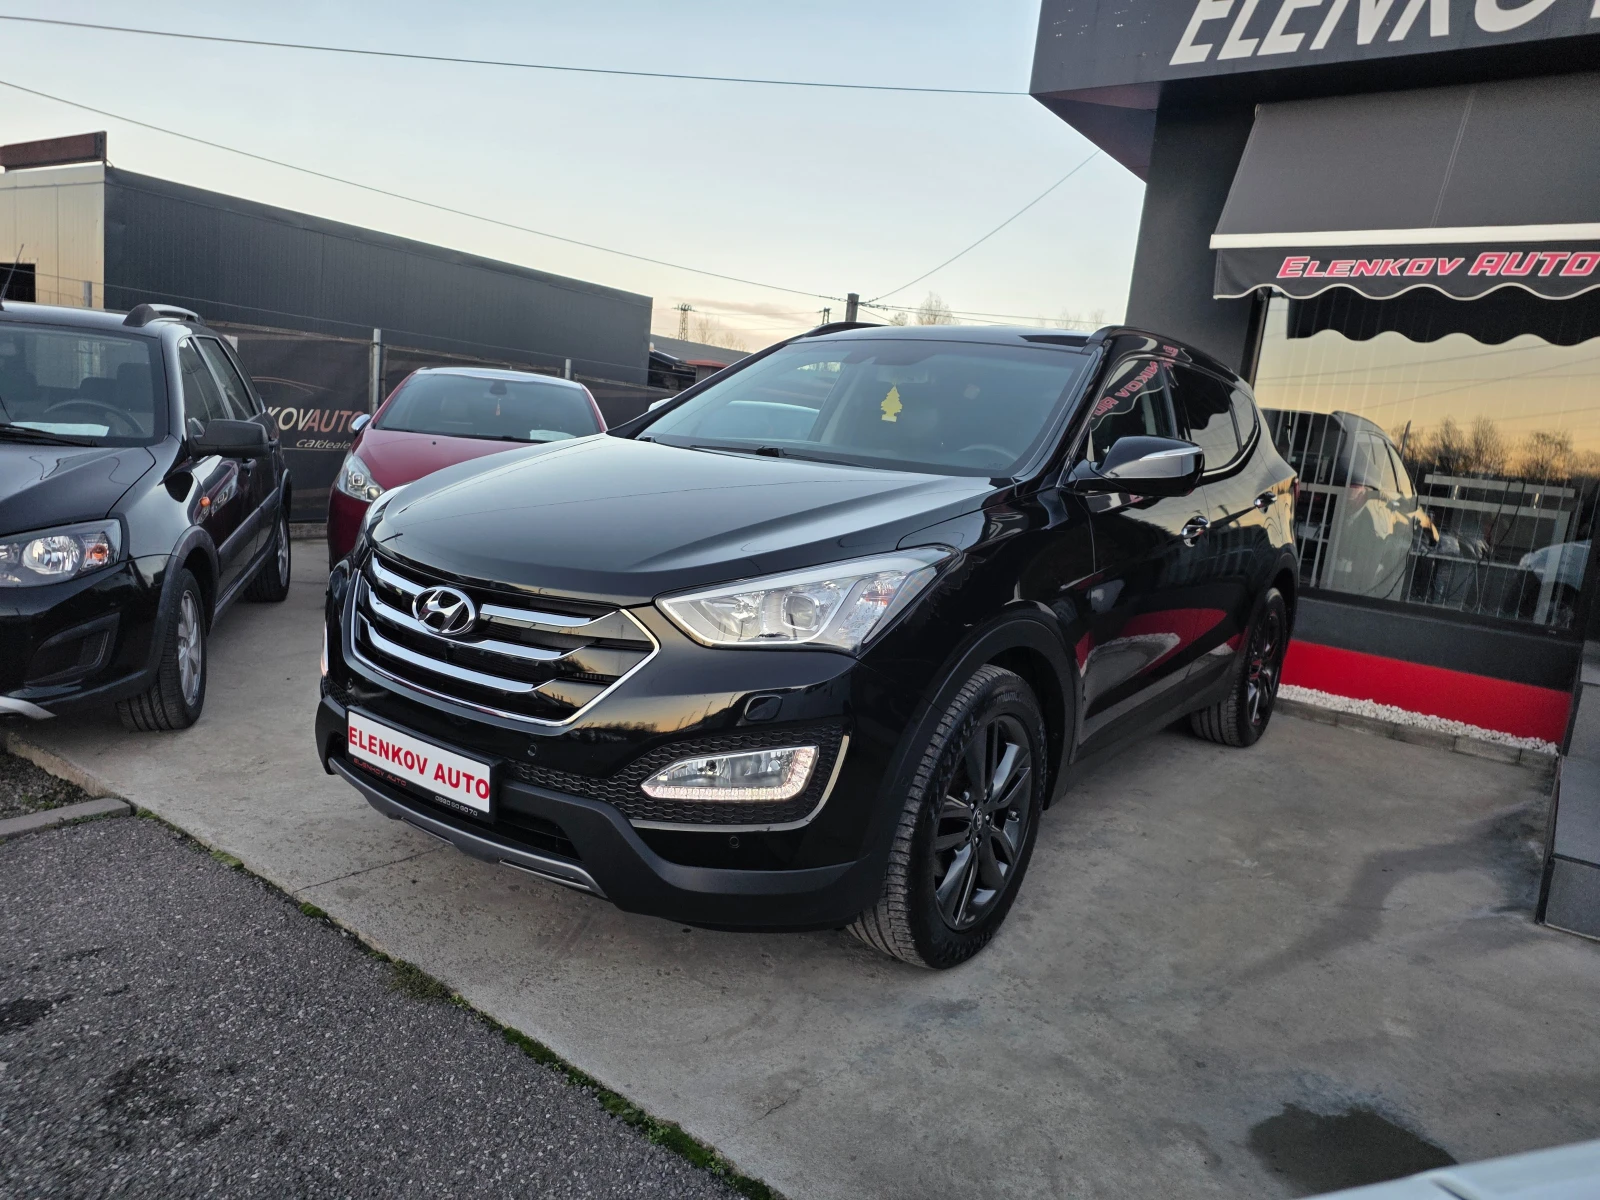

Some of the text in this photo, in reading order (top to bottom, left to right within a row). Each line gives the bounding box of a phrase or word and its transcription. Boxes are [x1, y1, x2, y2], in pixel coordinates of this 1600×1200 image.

[1169, 0, 1600, 66] ELEN
[1277, 251, 1600, 279] ELENKOV AUTO
[348, 726, 490, 799] ELENKOV AUTO
[353, 757, 407, 787] ELENKOV AUTO
